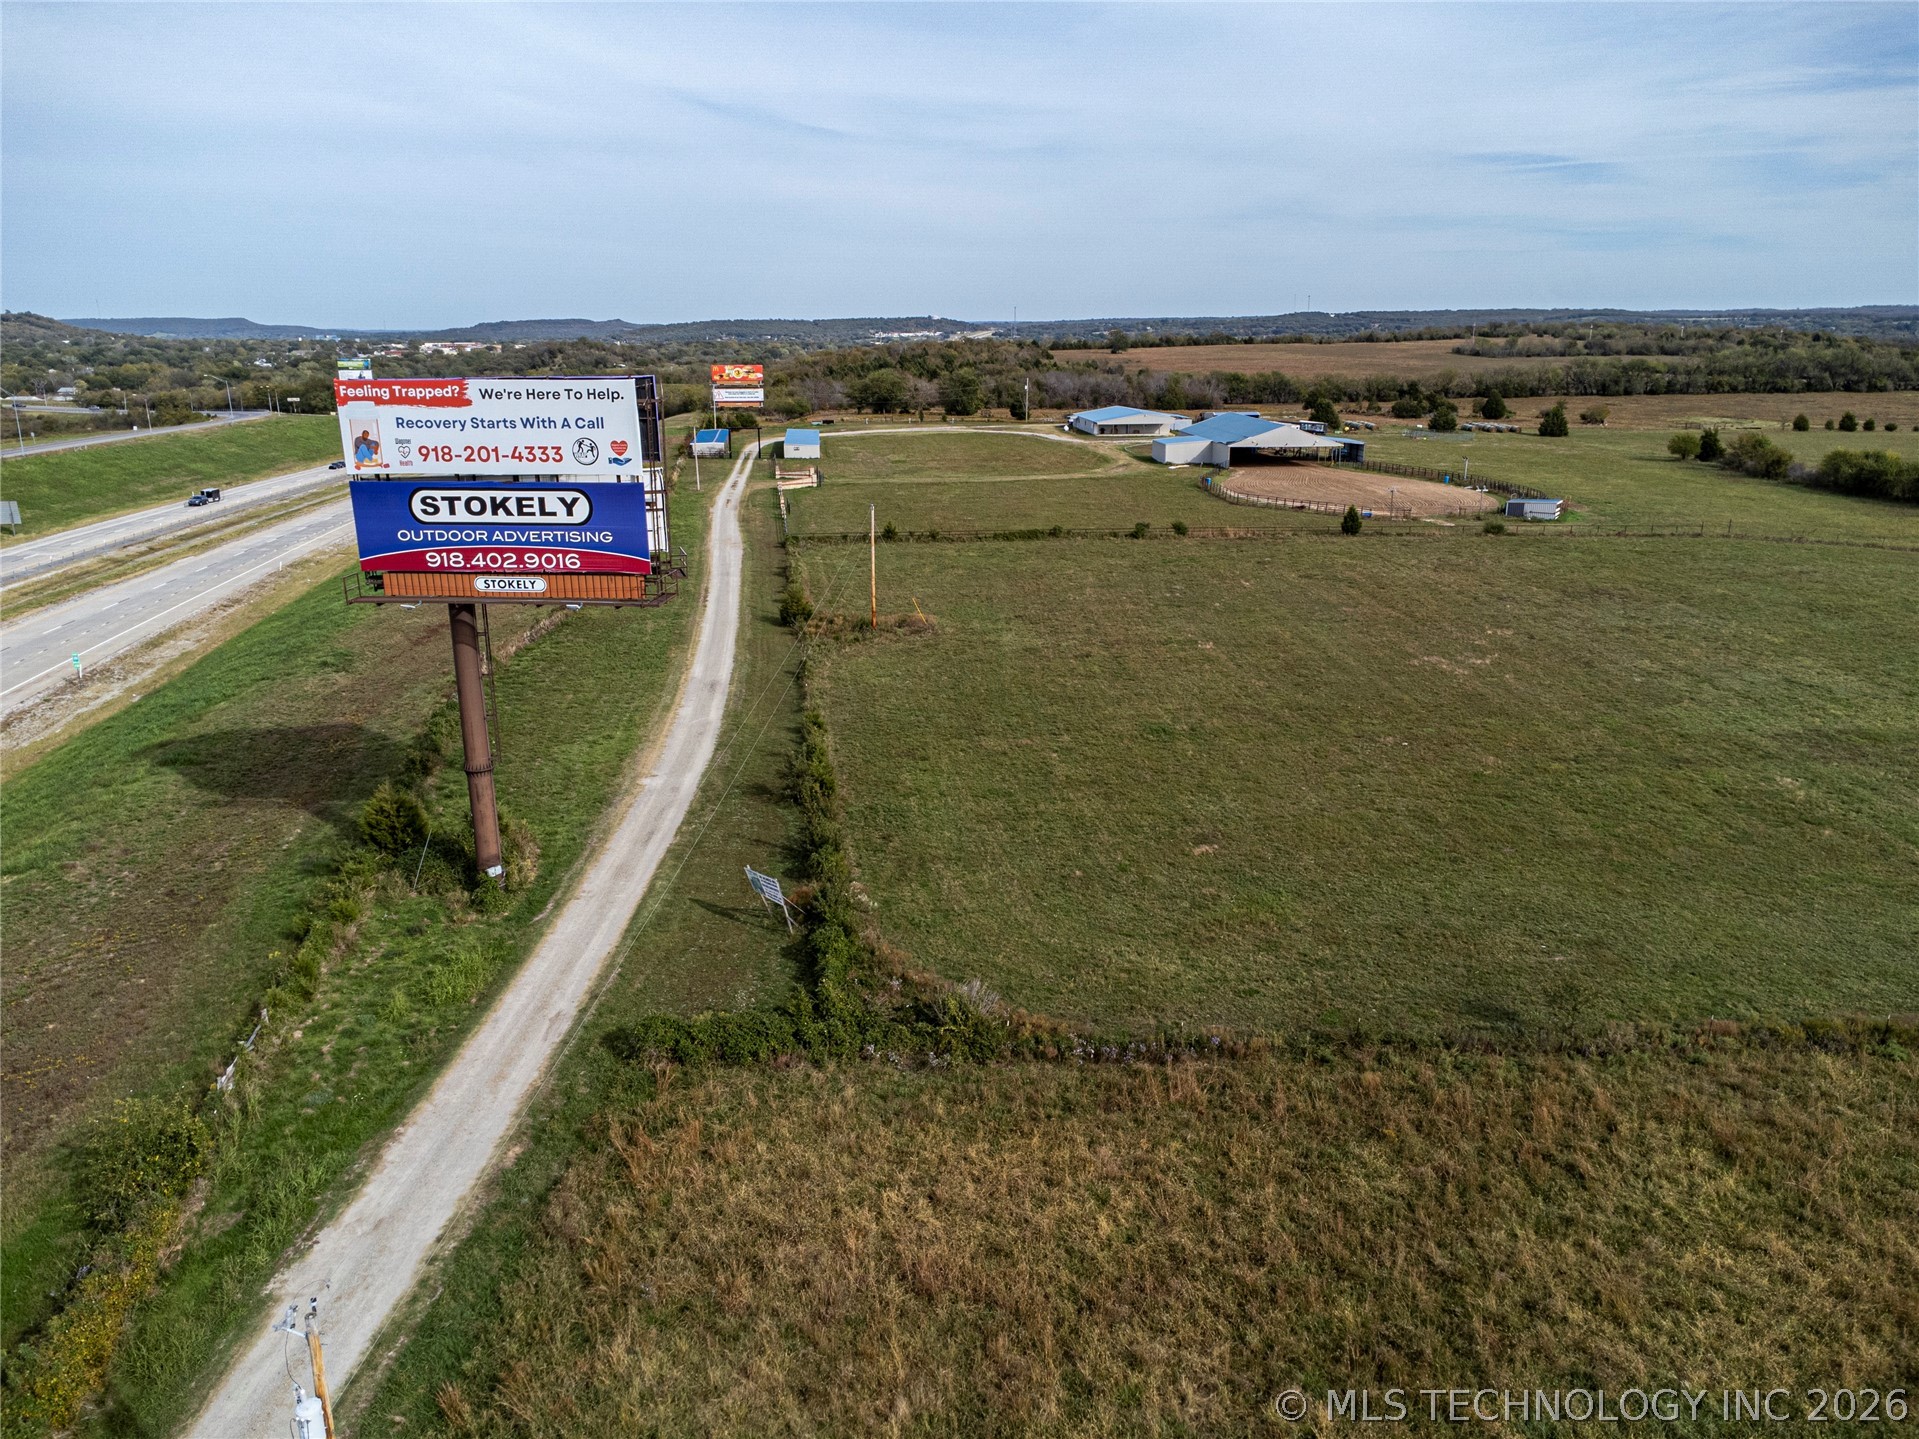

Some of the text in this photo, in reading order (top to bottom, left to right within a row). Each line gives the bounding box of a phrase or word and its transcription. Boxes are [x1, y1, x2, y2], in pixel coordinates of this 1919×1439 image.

[339, 385, 460, 399] Feeling Trapped?
[479, 388, 625, 402] We're Here To Help.
[395, 416, 605, 431] Recovery Starts With A Call
[417, 445, 564, 463] 918-201-4333
[420, 496, 582, 518] STOKELY
[397, 530, 613, 543] OUTDOOR ADVERTISING
[425, 552, 581, 569] 918.402.9016
[484, 579, 537, 590] STOKELY
